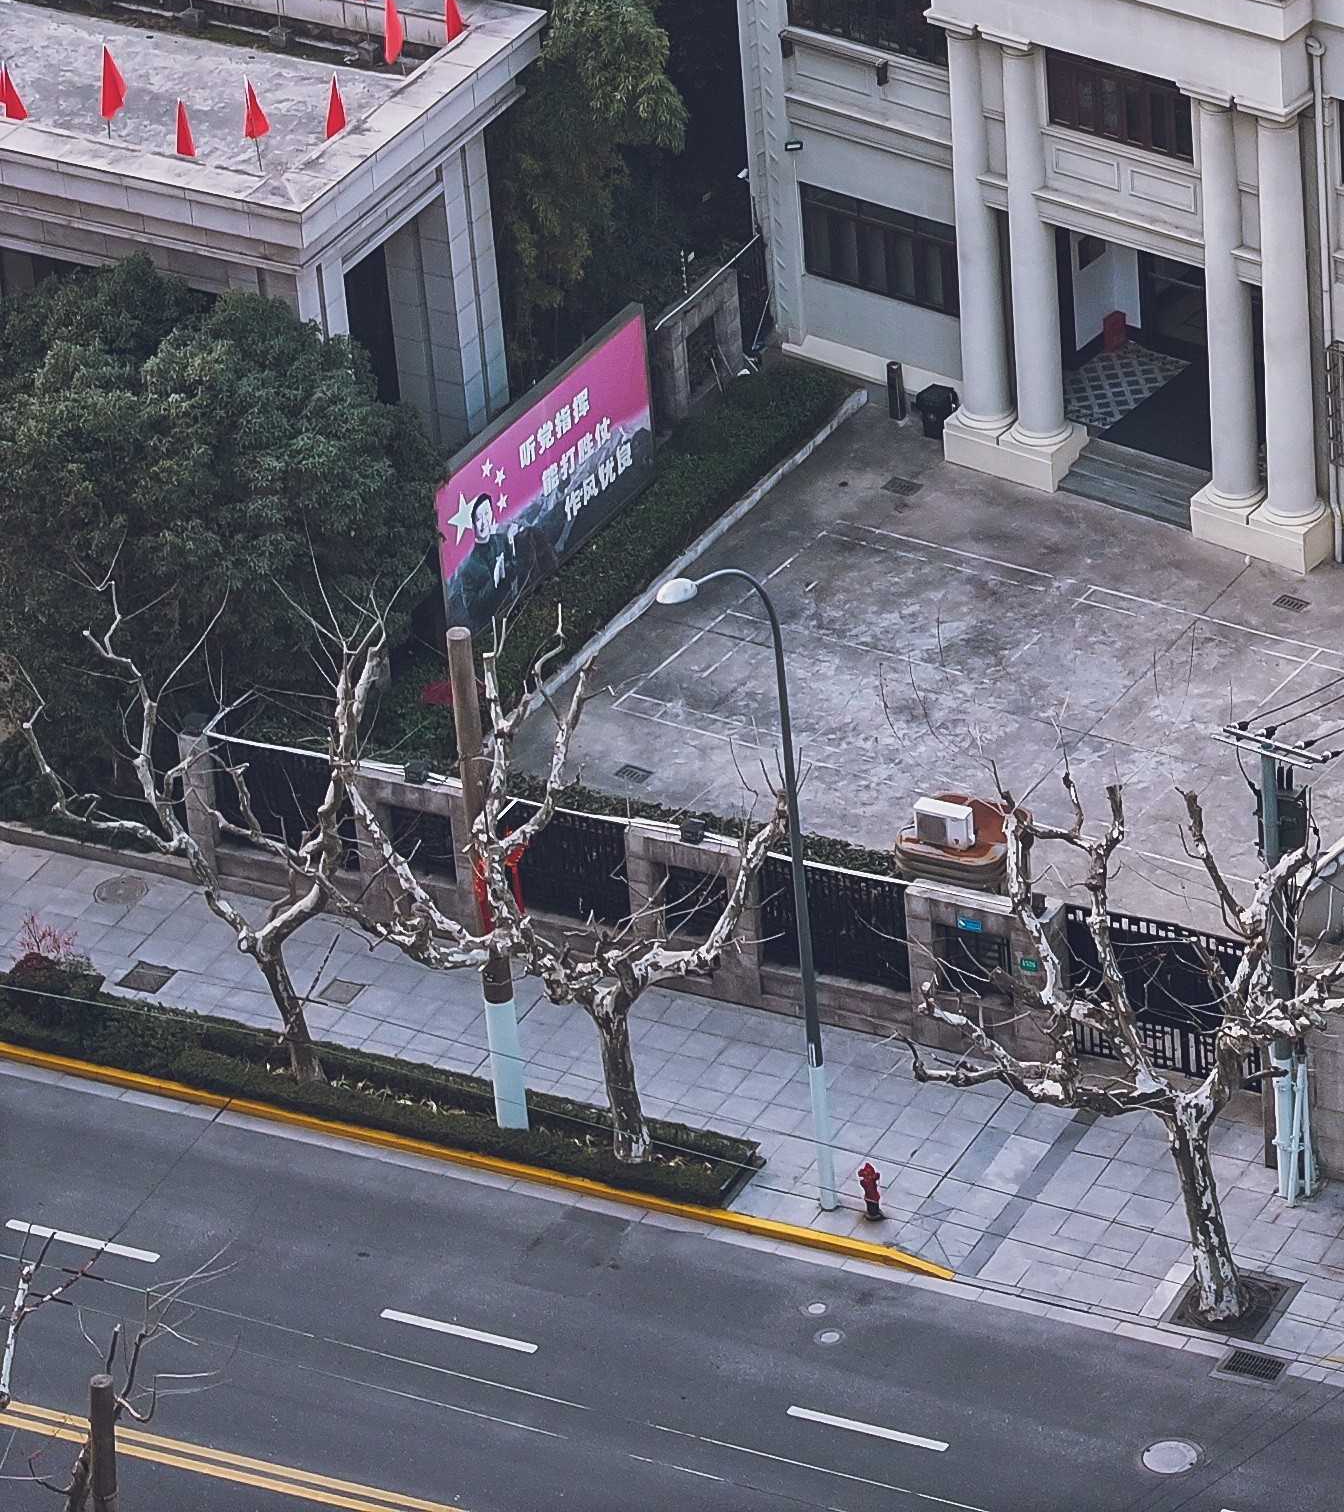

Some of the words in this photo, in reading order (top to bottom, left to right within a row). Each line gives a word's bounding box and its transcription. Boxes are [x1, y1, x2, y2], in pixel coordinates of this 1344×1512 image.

[519, 387, 590, 469] 听党指挥
[541, 416, 612, 498] 能打胜仗
[564, 441, 634, 522] 作风优良
